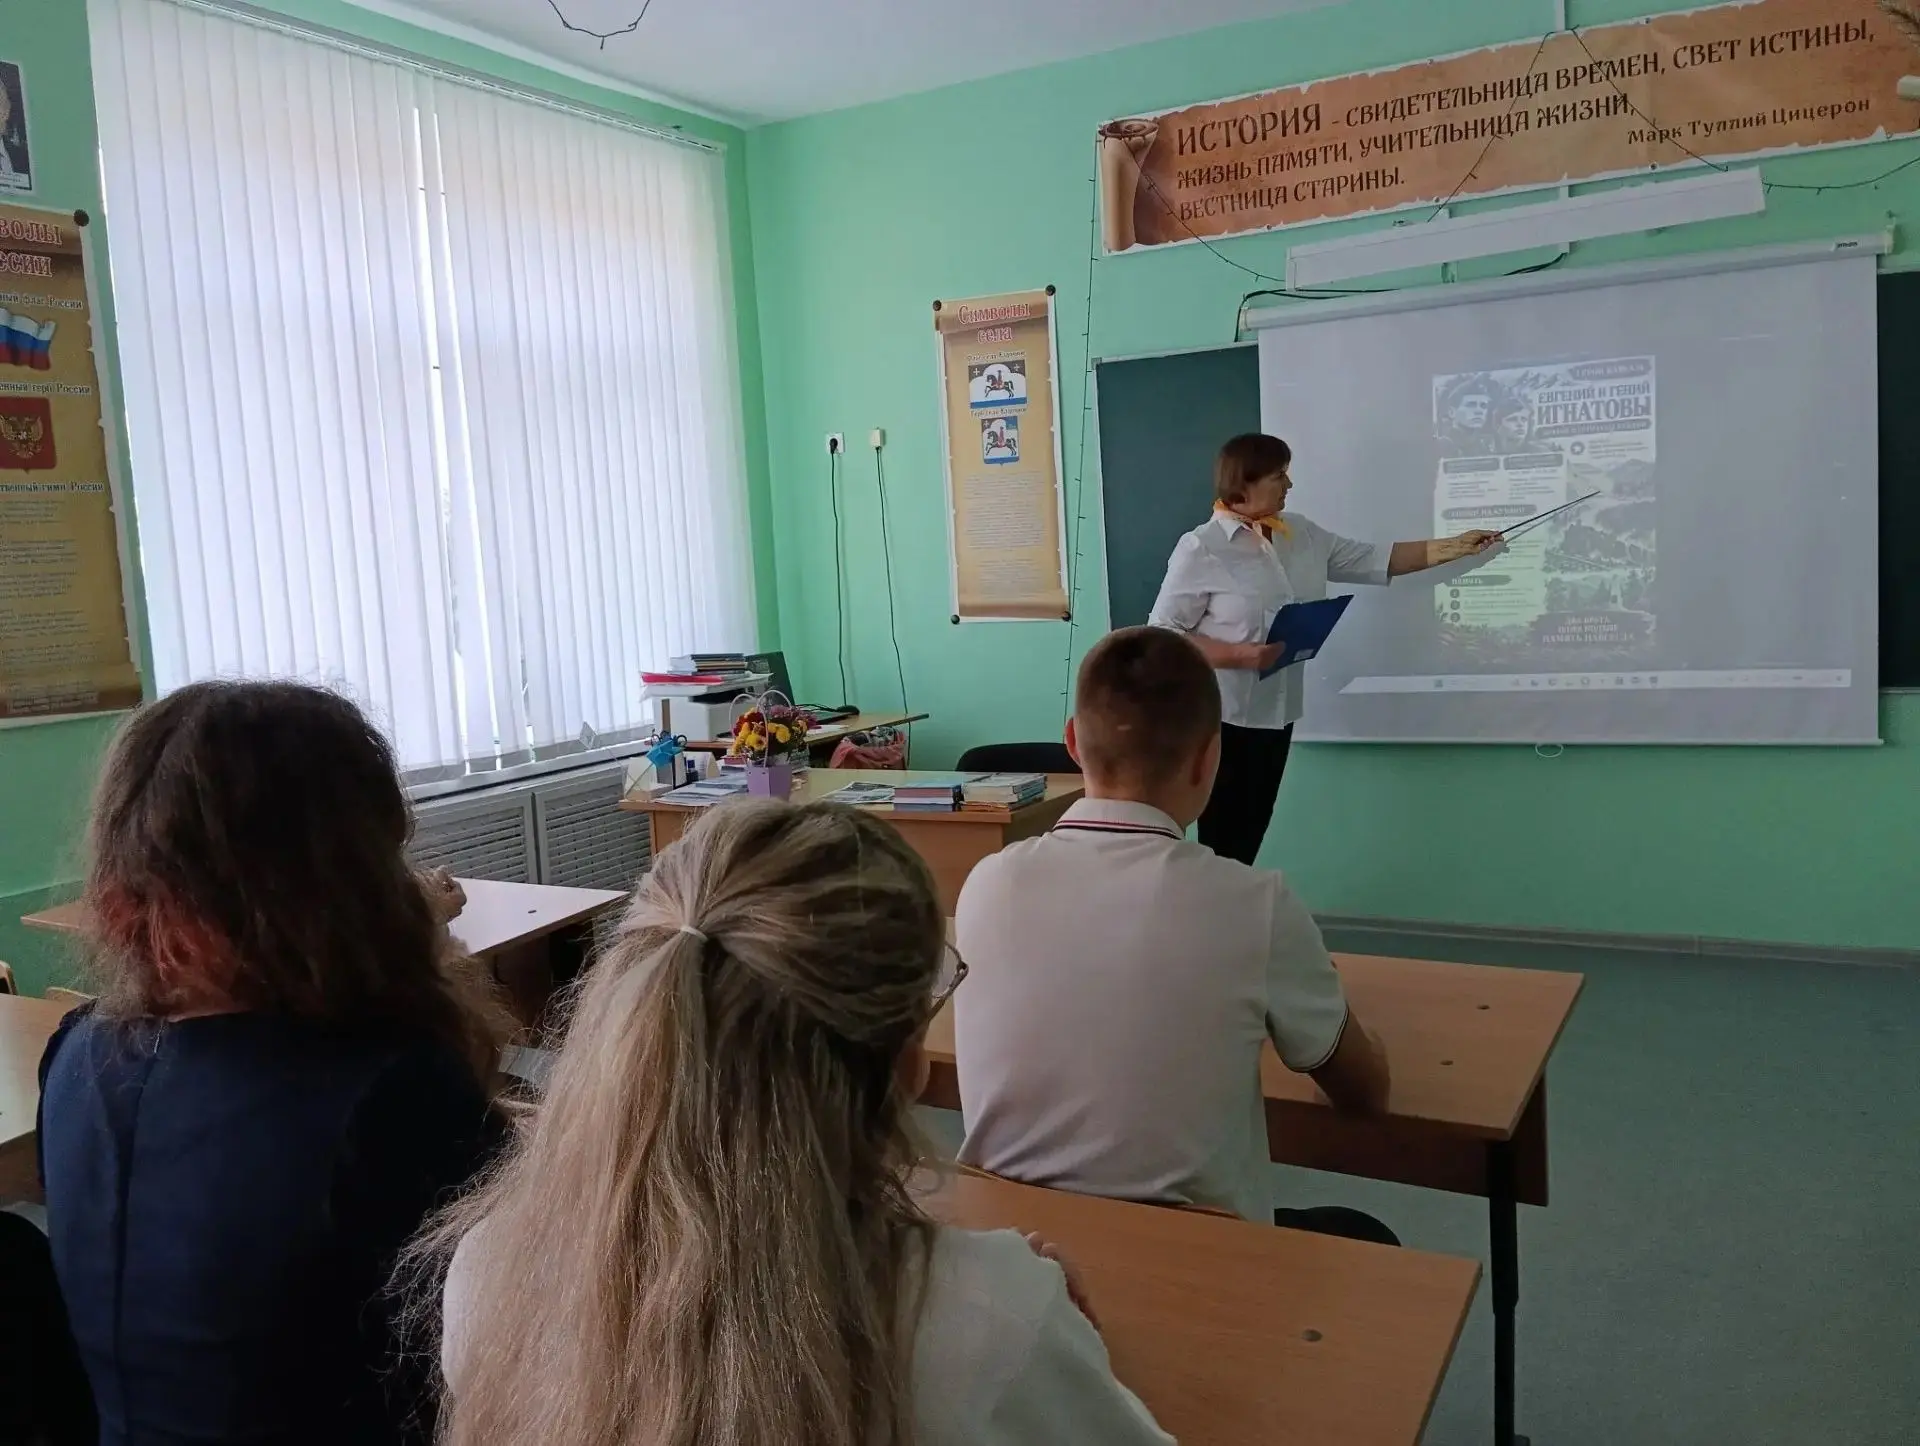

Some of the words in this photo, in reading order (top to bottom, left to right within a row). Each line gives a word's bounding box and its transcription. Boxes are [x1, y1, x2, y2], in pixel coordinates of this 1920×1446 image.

[1178, 103, 1321, 156] ИСТОРИЯ
[1346, 72, 1548, 127] СВИДЕТЕЛЬНИЦА
[1556, 52, 1666, 90] ВРЕМЕН,
[1673, 39, 1741, 69] СВЕТ
[1750, 19, 1876, 57] ИСТИНЫ,
[1177, 161, 1251, 189] ЖИЗНЬ
[1258, 142, 1352, 177] ПАМЯТИ,
[1360, 110, 1529, 158] УЧИТЕЛЬНИЦА
[1537, 93, 1635, 128] ЖИЗНИ,
[1628, 126, 1683, 144] Марк
[1688, 112, 1767, 137] Туллий
[1772, 98, 1870, 126] Цицерон
[1181, 185, 1288, 221] ВЕСТНИЦА
[1294, 167, 1405, 201] СТАРИНЫ.
[1537, 395, 1652, 425] ИГНАТОВЫ
